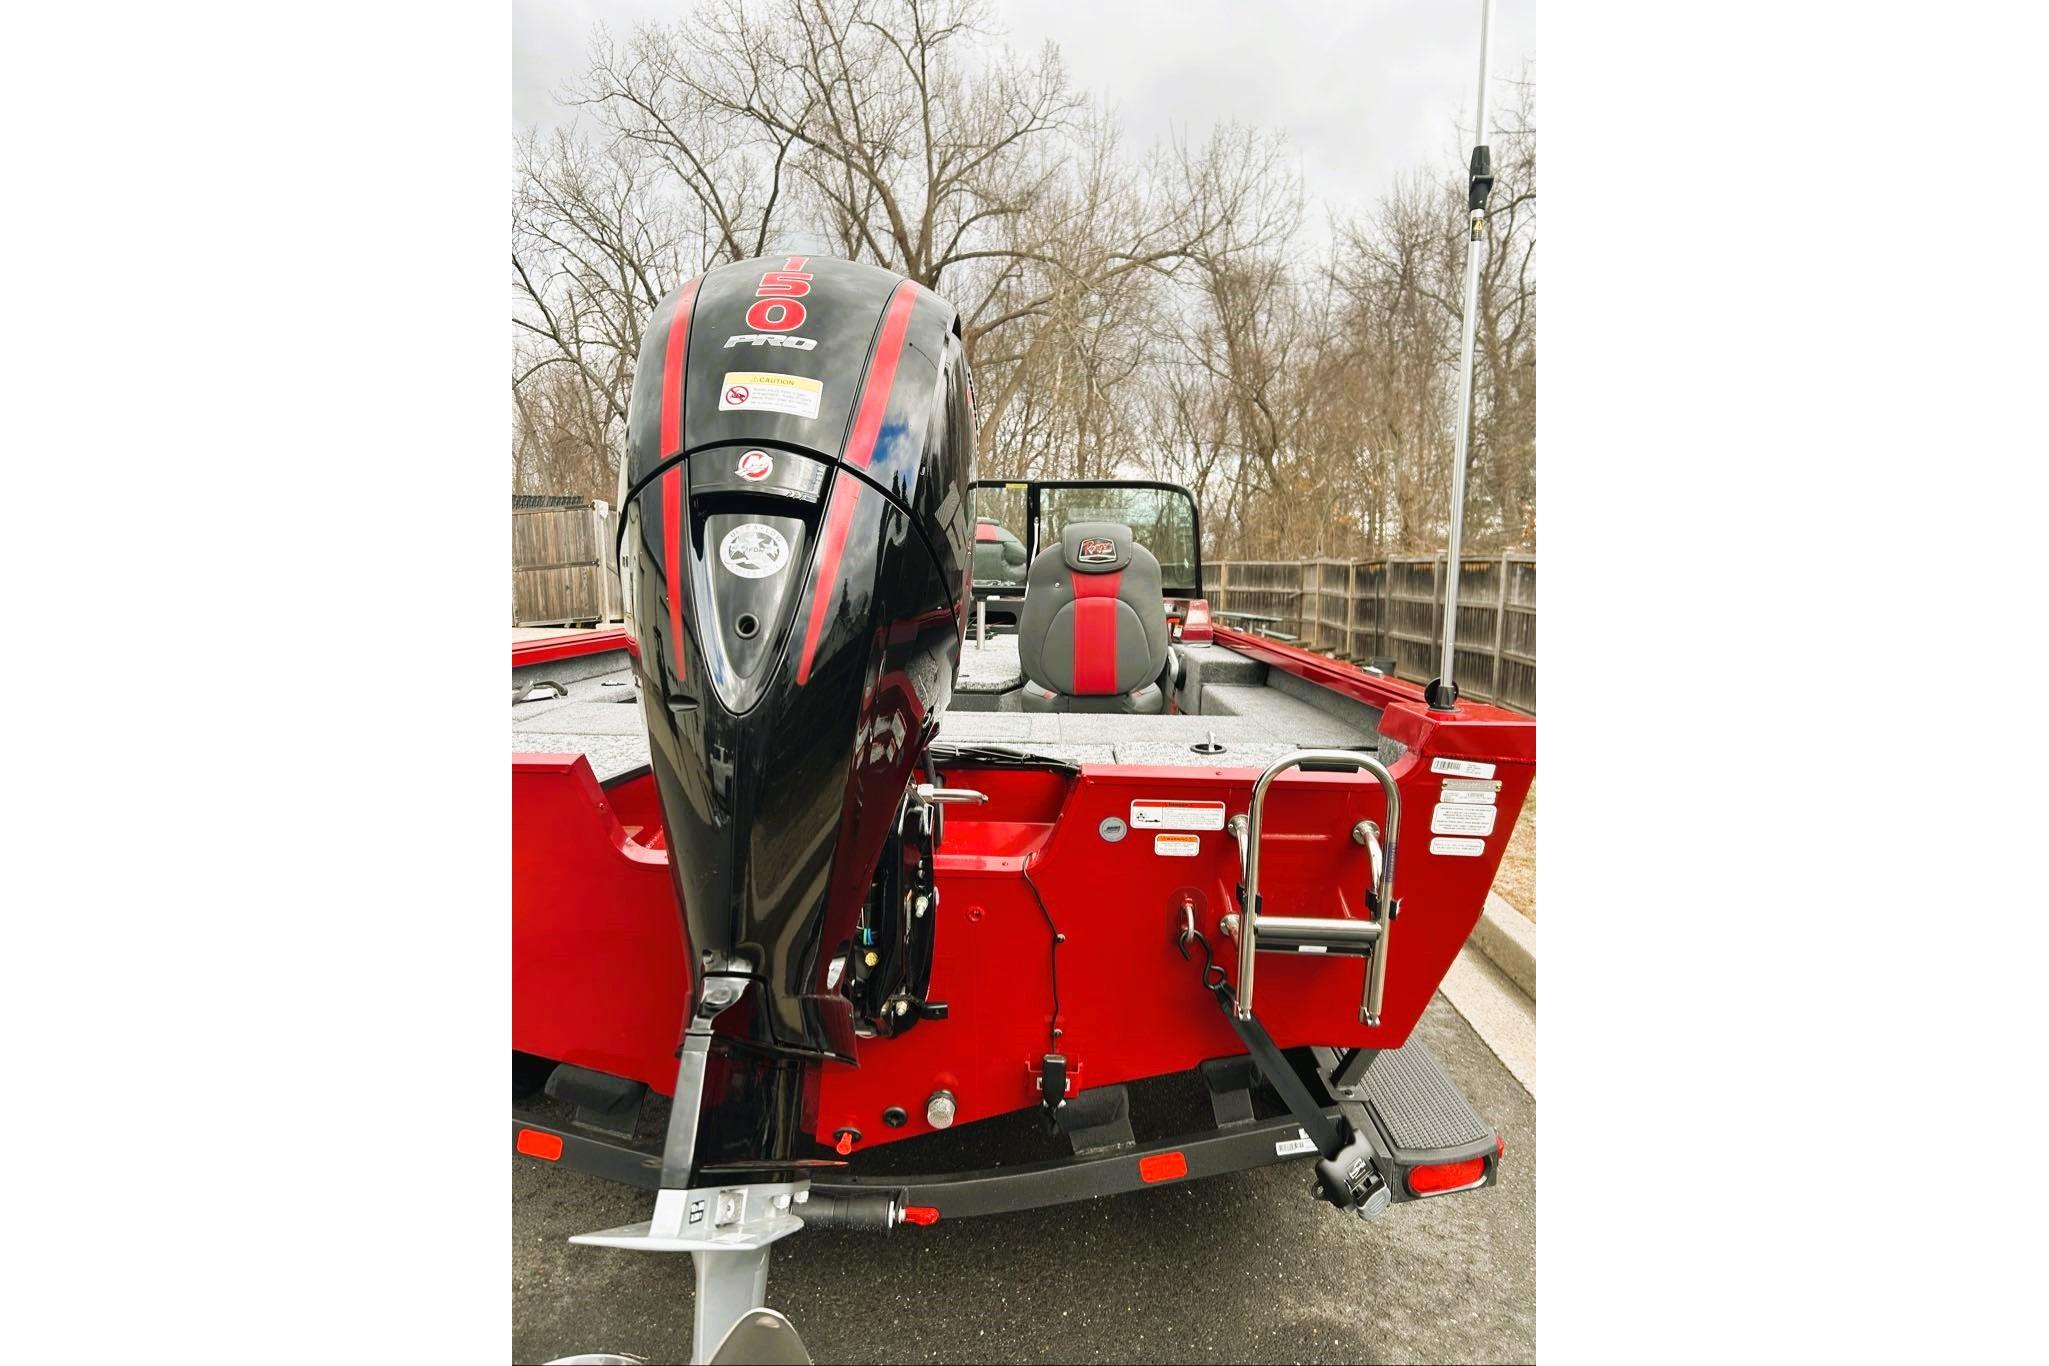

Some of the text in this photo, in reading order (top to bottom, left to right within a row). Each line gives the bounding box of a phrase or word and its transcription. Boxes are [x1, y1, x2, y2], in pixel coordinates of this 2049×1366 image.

[745, 256, 814, 332] 150
[723, 333, 818, 351] PRO
[759, 376, 795, 386] CAUTION
